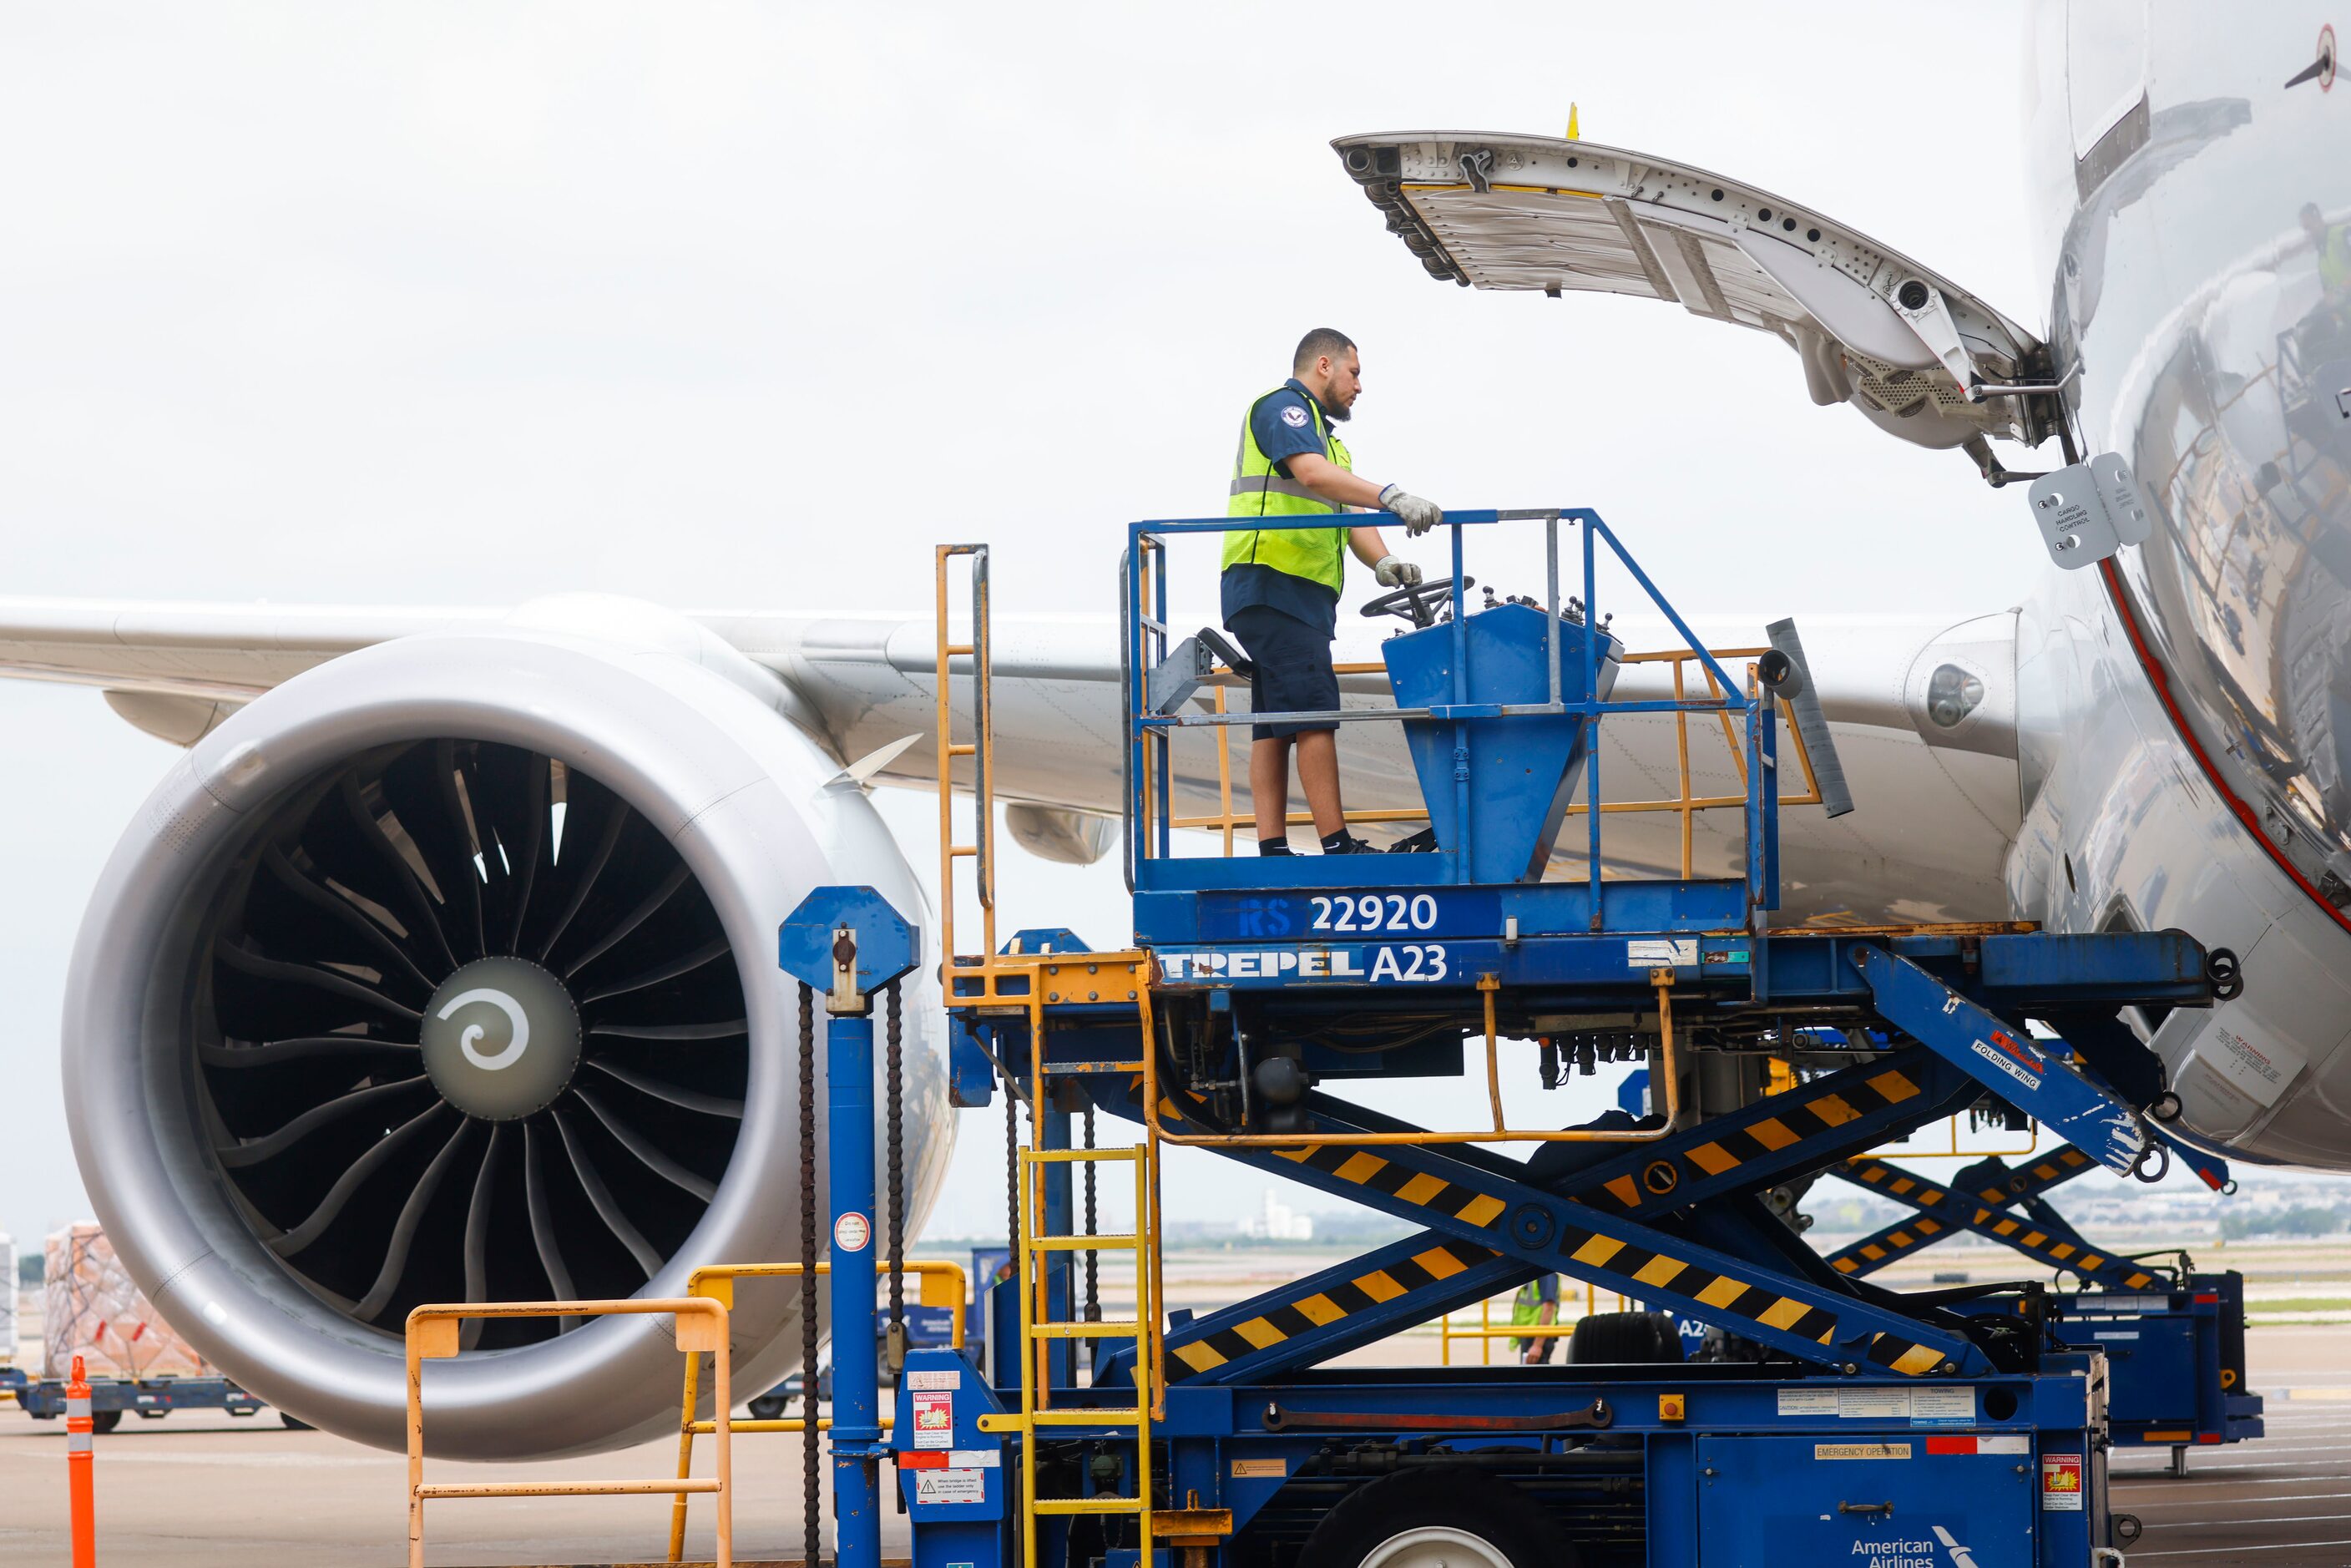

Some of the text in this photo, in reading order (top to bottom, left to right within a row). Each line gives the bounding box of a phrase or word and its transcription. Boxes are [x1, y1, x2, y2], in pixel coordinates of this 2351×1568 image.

[2055, 509, 2088, 525] HANDLING
[2057, 504, 2080, 517] CARGO
[2059, 517, 2091, 532] CONTROL
[1311, 894, 1438, 931] 22920
[1157, 944, 1447, 982] TREPEL A23
[2236, 1034, 2271, 1065] WARNING
[1974, 1043, 2012, 1071] FOLDING
[2014, 1068, 2037, 1087] WING
[1678, 1319, 1706, 1338] A2
[1817, 1447, 1909, 1456] EMERGENCY OPERATION
[1852, 1538, 1934, 1555] American
[1869, 1555, 1934, 1568] Airlines
